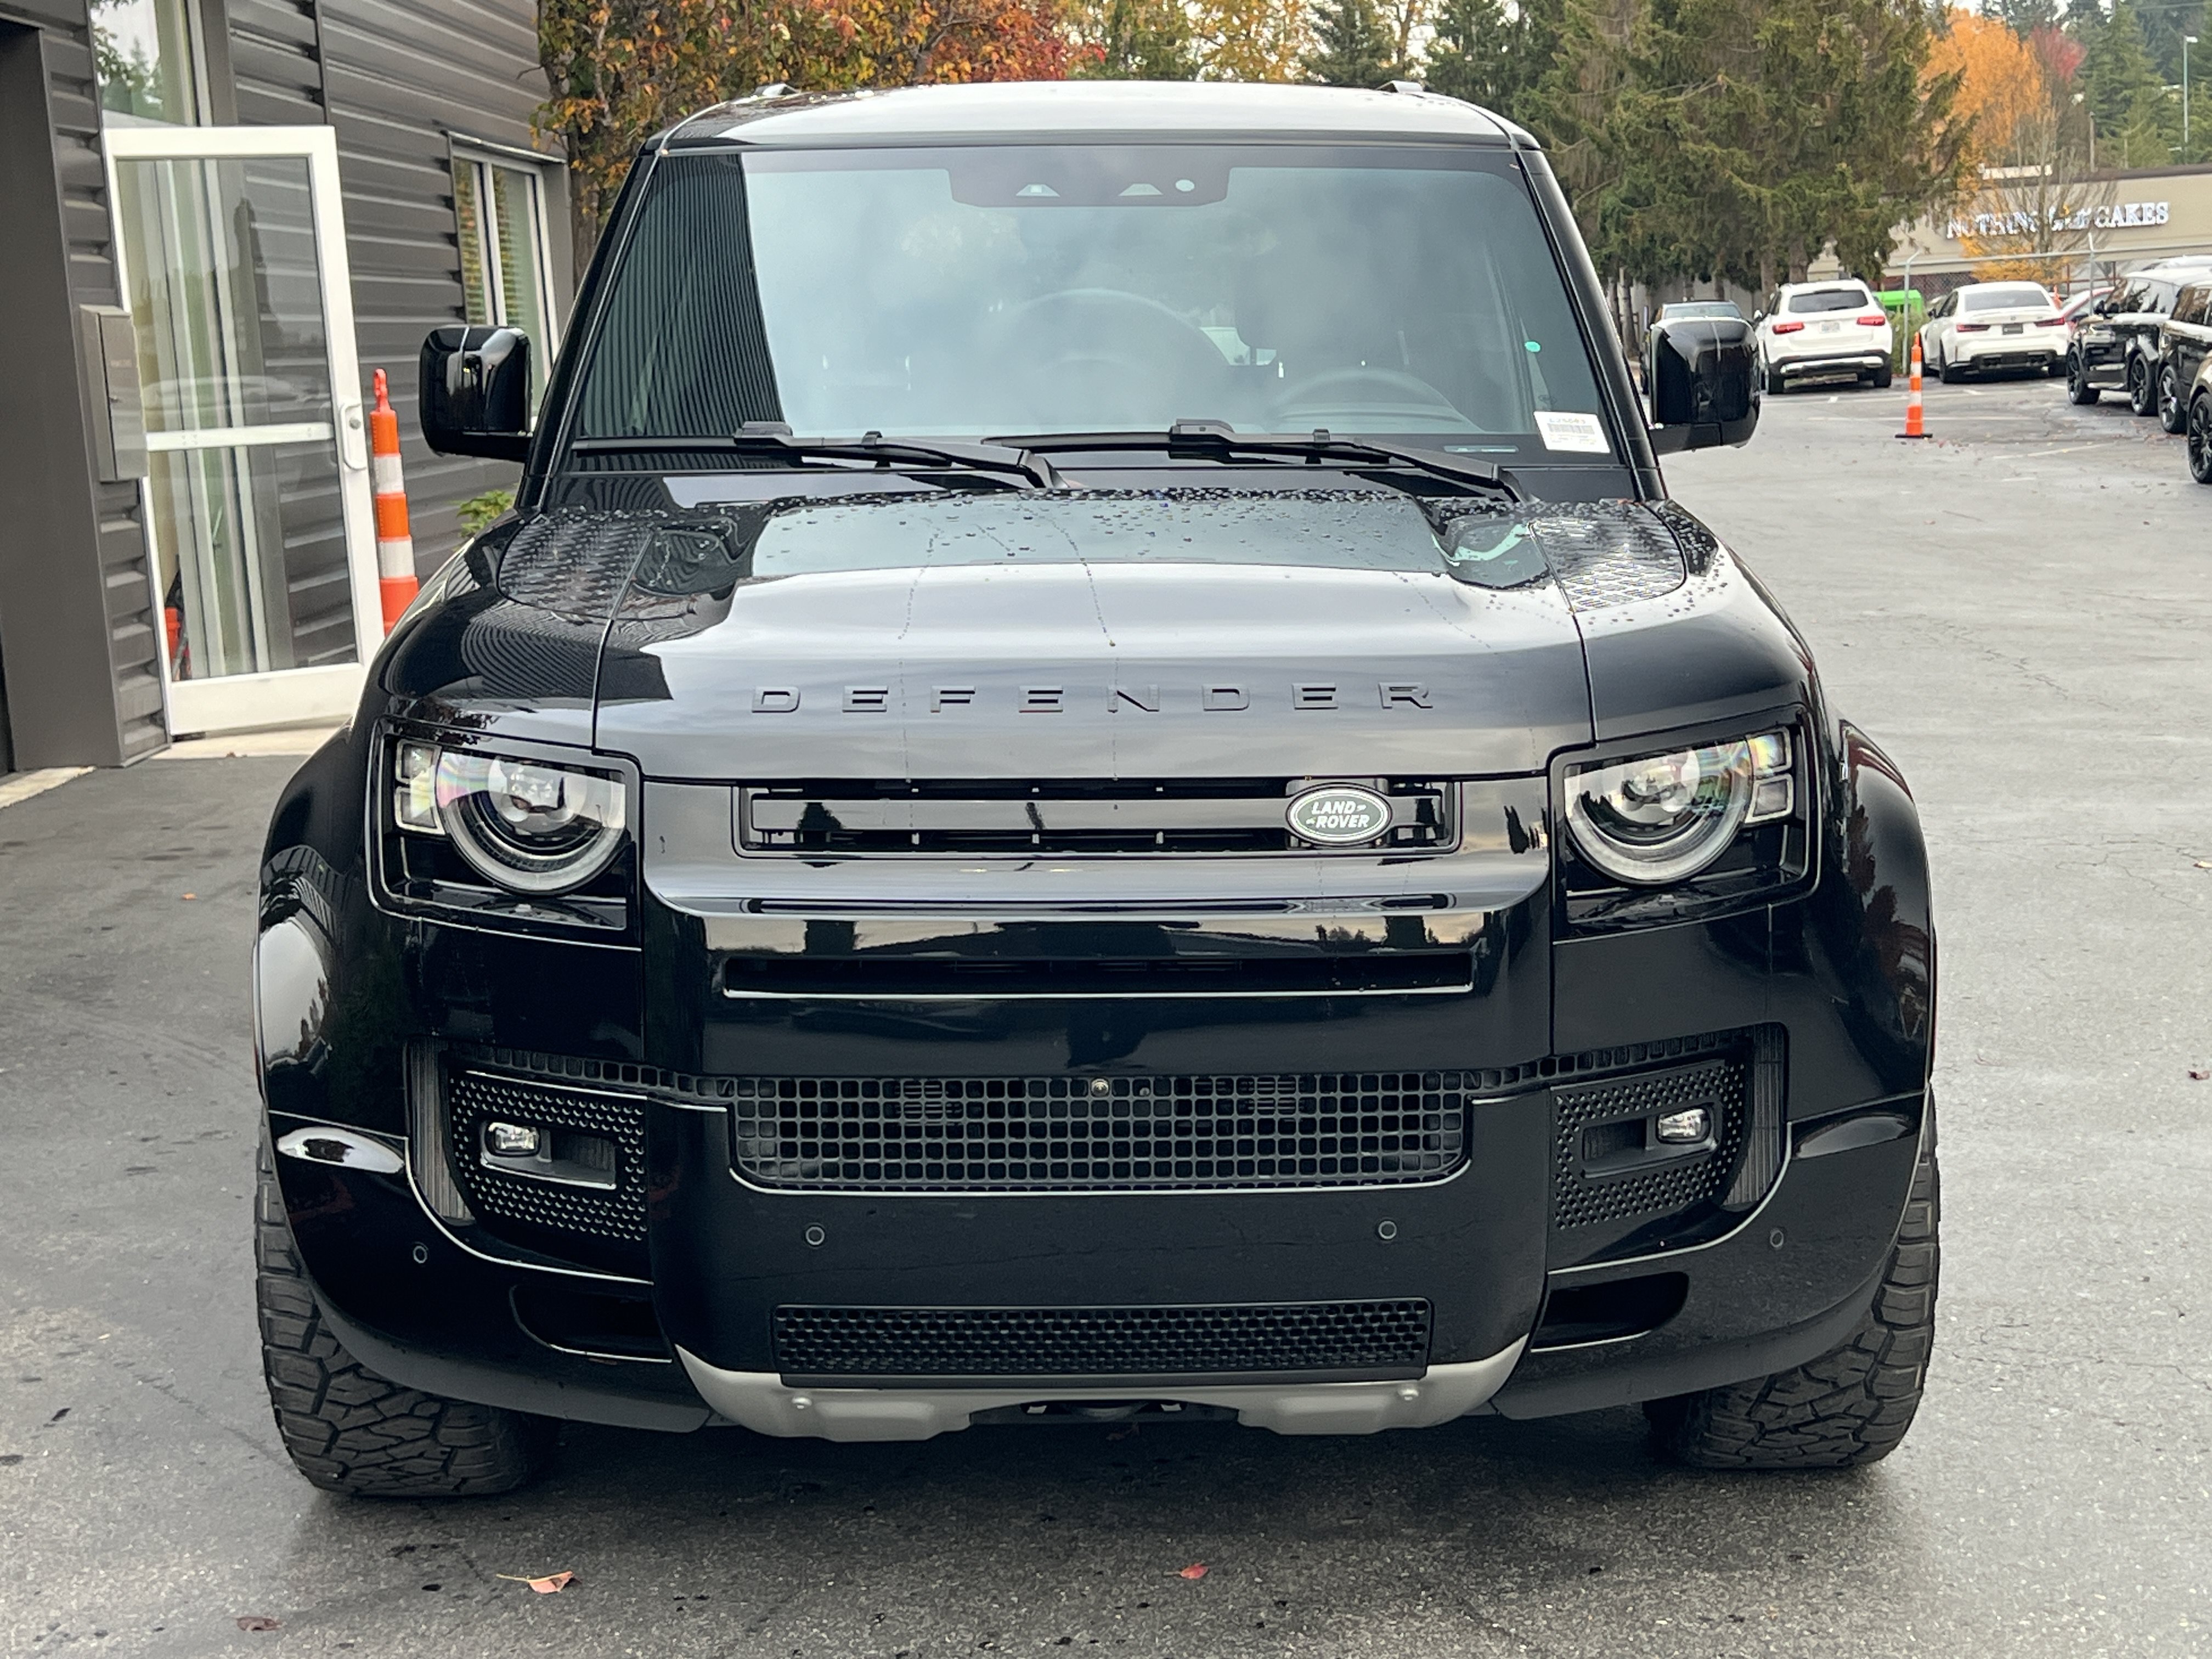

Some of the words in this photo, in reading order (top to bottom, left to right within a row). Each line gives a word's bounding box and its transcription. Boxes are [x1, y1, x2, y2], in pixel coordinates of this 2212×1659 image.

[2094, 201, 2169, 228] CAKES
[752, 682, 1432, 713] DEFENDER
[1311, 801, 1356, 815] LAND
[1315, 815, 1370, 829] ROVER
